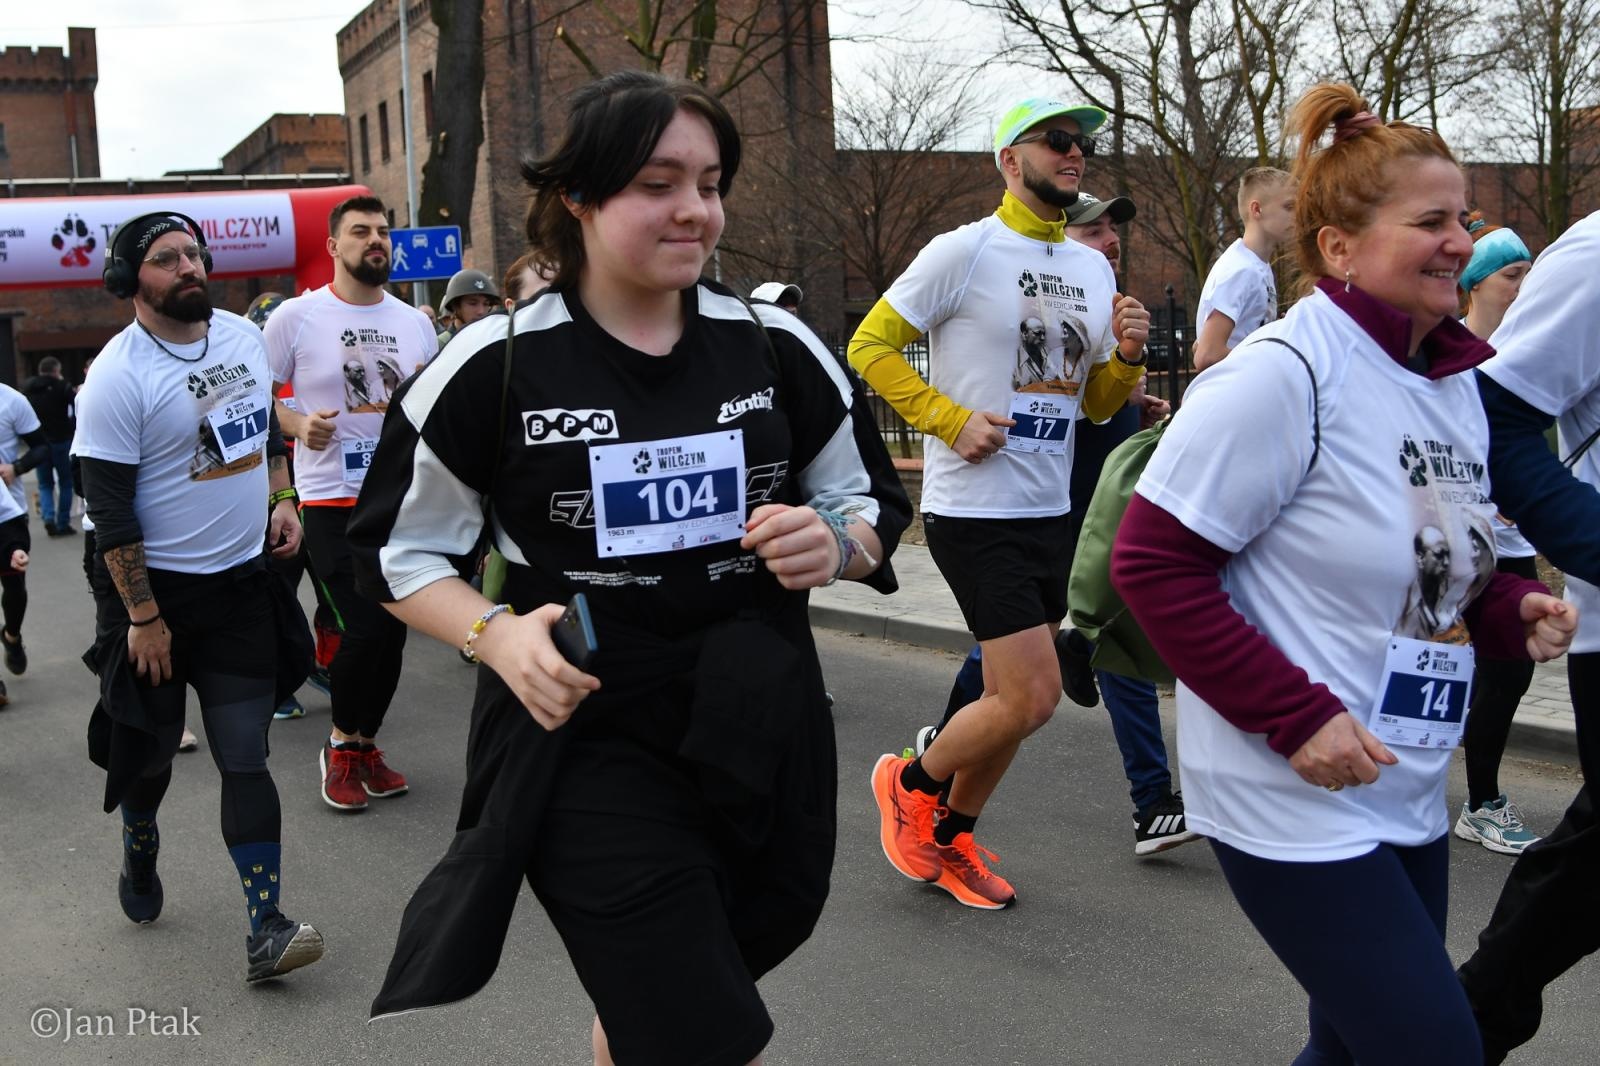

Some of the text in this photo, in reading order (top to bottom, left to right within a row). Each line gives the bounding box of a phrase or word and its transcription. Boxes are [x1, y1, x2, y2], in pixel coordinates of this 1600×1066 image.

[1039, 272, 1063, 283] TROPEM
[1041, 281, 1086, 299] WILCZYM
[360, 334, 397, 345] WILCZYM
[202, 363, 225, 377] TROPEM
[207, 363, 250, 388] WILCZYM
[234, 414, 258, 439] 71
[1033, 418, 1057, 439] 17
[656, 446, 682, 456] TROPEM
[362, 452, 375, 468] 8
[658, 451, 706, 469] WILCZYM
[637, 474, 719, 521] 104
[721, 514, 738, 523] 2026
[607, 528, 635, 537] 1963 m
[1420, 680, 1452, 719] 14
